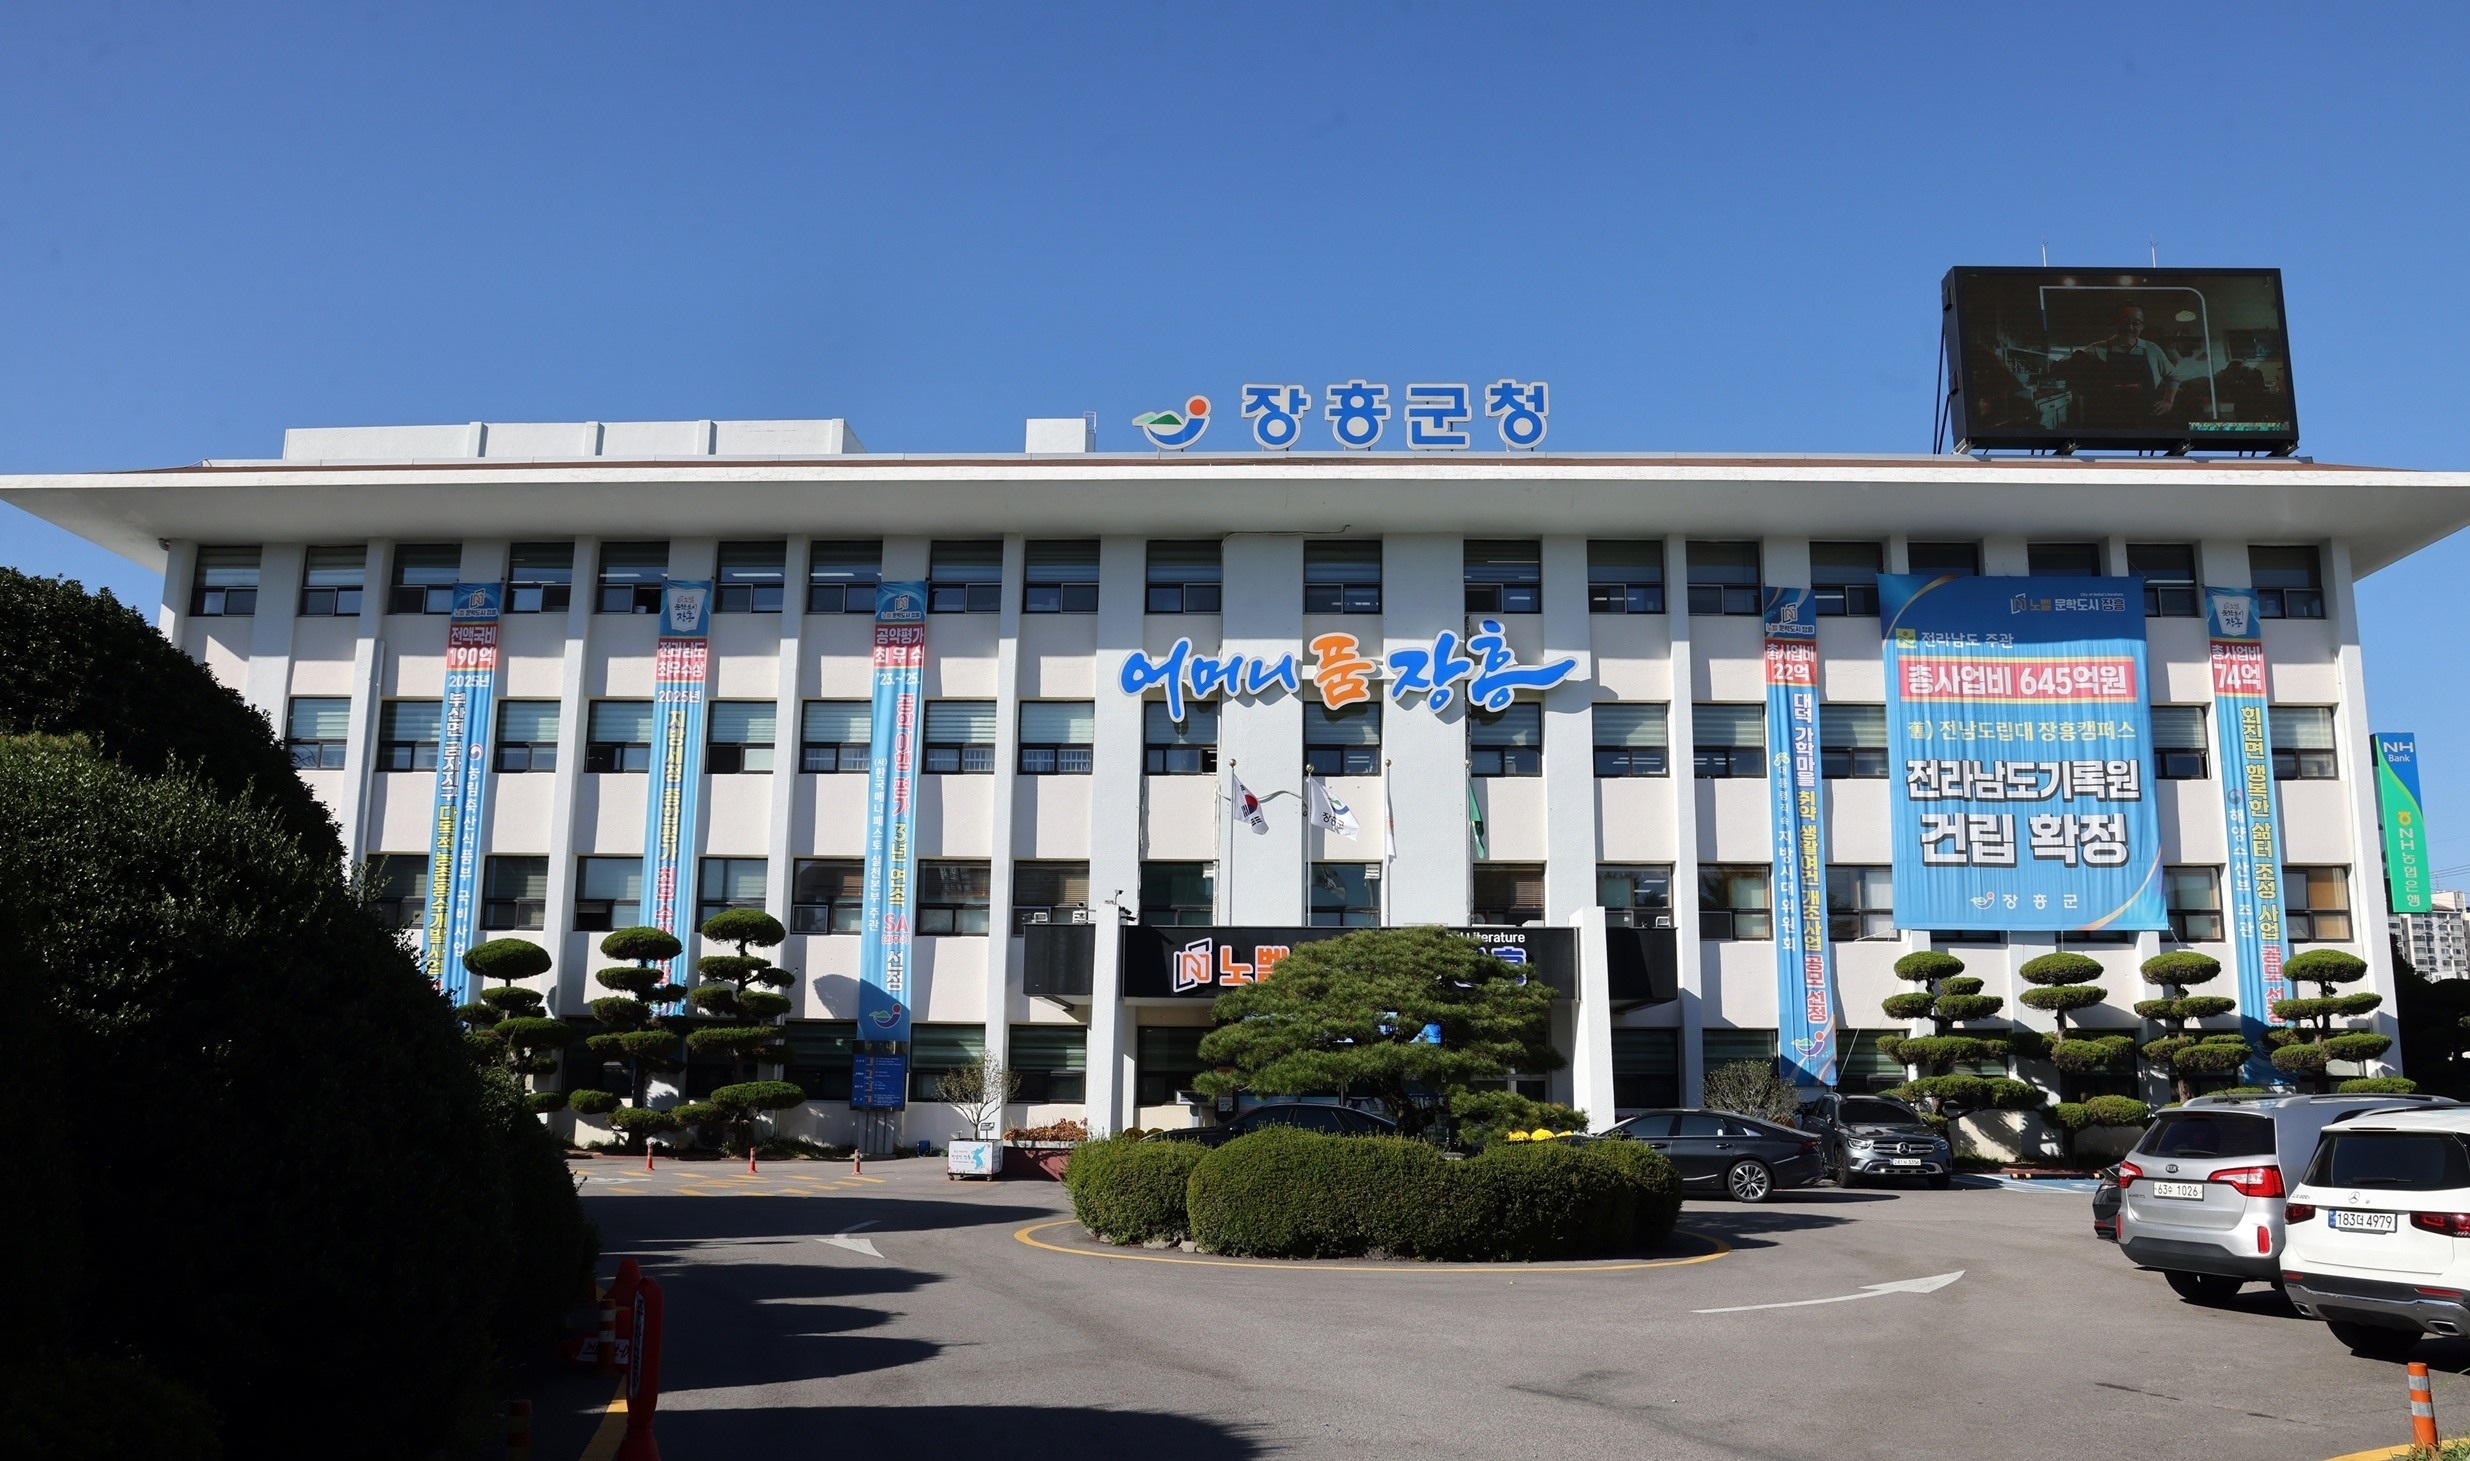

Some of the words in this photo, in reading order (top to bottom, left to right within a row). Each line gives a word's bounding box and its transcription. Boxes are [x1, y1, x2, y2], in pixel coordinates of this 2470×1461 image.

[1242, 379, 1548, 449] 장흥군청
[2054, 598, 2099, 611] 문학도시
[2102, 597, 2126, 611] 장흥
[451, 626, 497, 645] 전액국비
[876, 627, 923, 645] 공약평가
[1922, 632, 1981, 648] 전라남도
[1984, 632, 2015, 649] 주관
[449, 647, 494, 666] 190억
[659, 641, 705, 659] 전라남도
[875, 646, 923, 664] 최우수
[1767, 643, 1814, 662] 총사업비
[2211, 644, 2260, 662] 총사업비
[657, 660, 705, 678] 최우수상
[1118, 636, 1302, 723] 어머니
[1309, 631, 1378, 710] 품
[1383, 619, 1580, 714] 장흥
[1774, 663, 1810, 681] 22억
[1908, 663, 2012, 696] 총사업비
[2019, 665, 2127, 696] 645억원
[2213, 663, 2262, 690] 74억
[448, 674, 491, 688] 2025년
[657, 689, 702, 704] 2025년
[445, 692, 467, 737] 부산면
[1794, 693, 1812, 724] 대덕
[1939, 720, 2034, 742] 전남도립대
[2038, 720, 2136, 742] 장흥캠퍼스
[2383, 741, 2414, 753] NH
[2388, 754, 2411, 763] Bank
[1905, 759, 2141, 802] 전라남도기록원
[2245, 764, 2270, 818] 행복한
[459, 766, 480, 881] 농림축산식품부
[1920, 812, 2017, 868] 건립
[2028, 812, 2129, 868] 확정
[2251, 822, 2274, 859] 삶터
[1779, 830, 1796, 952] 지방시대위원회
[2254, 862, 2277, 900] 조성
[2003, 893, 2078, 910] 장흥군
[453, 889, 471, 957] 국비사업
[867, 907, 880, 932] 주관
[883, 912, 909, 933] SA
[2258, 904, 2280, 941] 사업
[886, 949, 904, 991] 선정
[1805, 954, 1825, 989] 공모
[2261, 943, 2284, 983] 공모
[1807, 989, 1829, 1024] 선정
[2177, 1185, 2198, 1197] 1026
[2338, 1212, 2363, 1227] 183더
[2366, 1214, 2393, 1229] 4979
